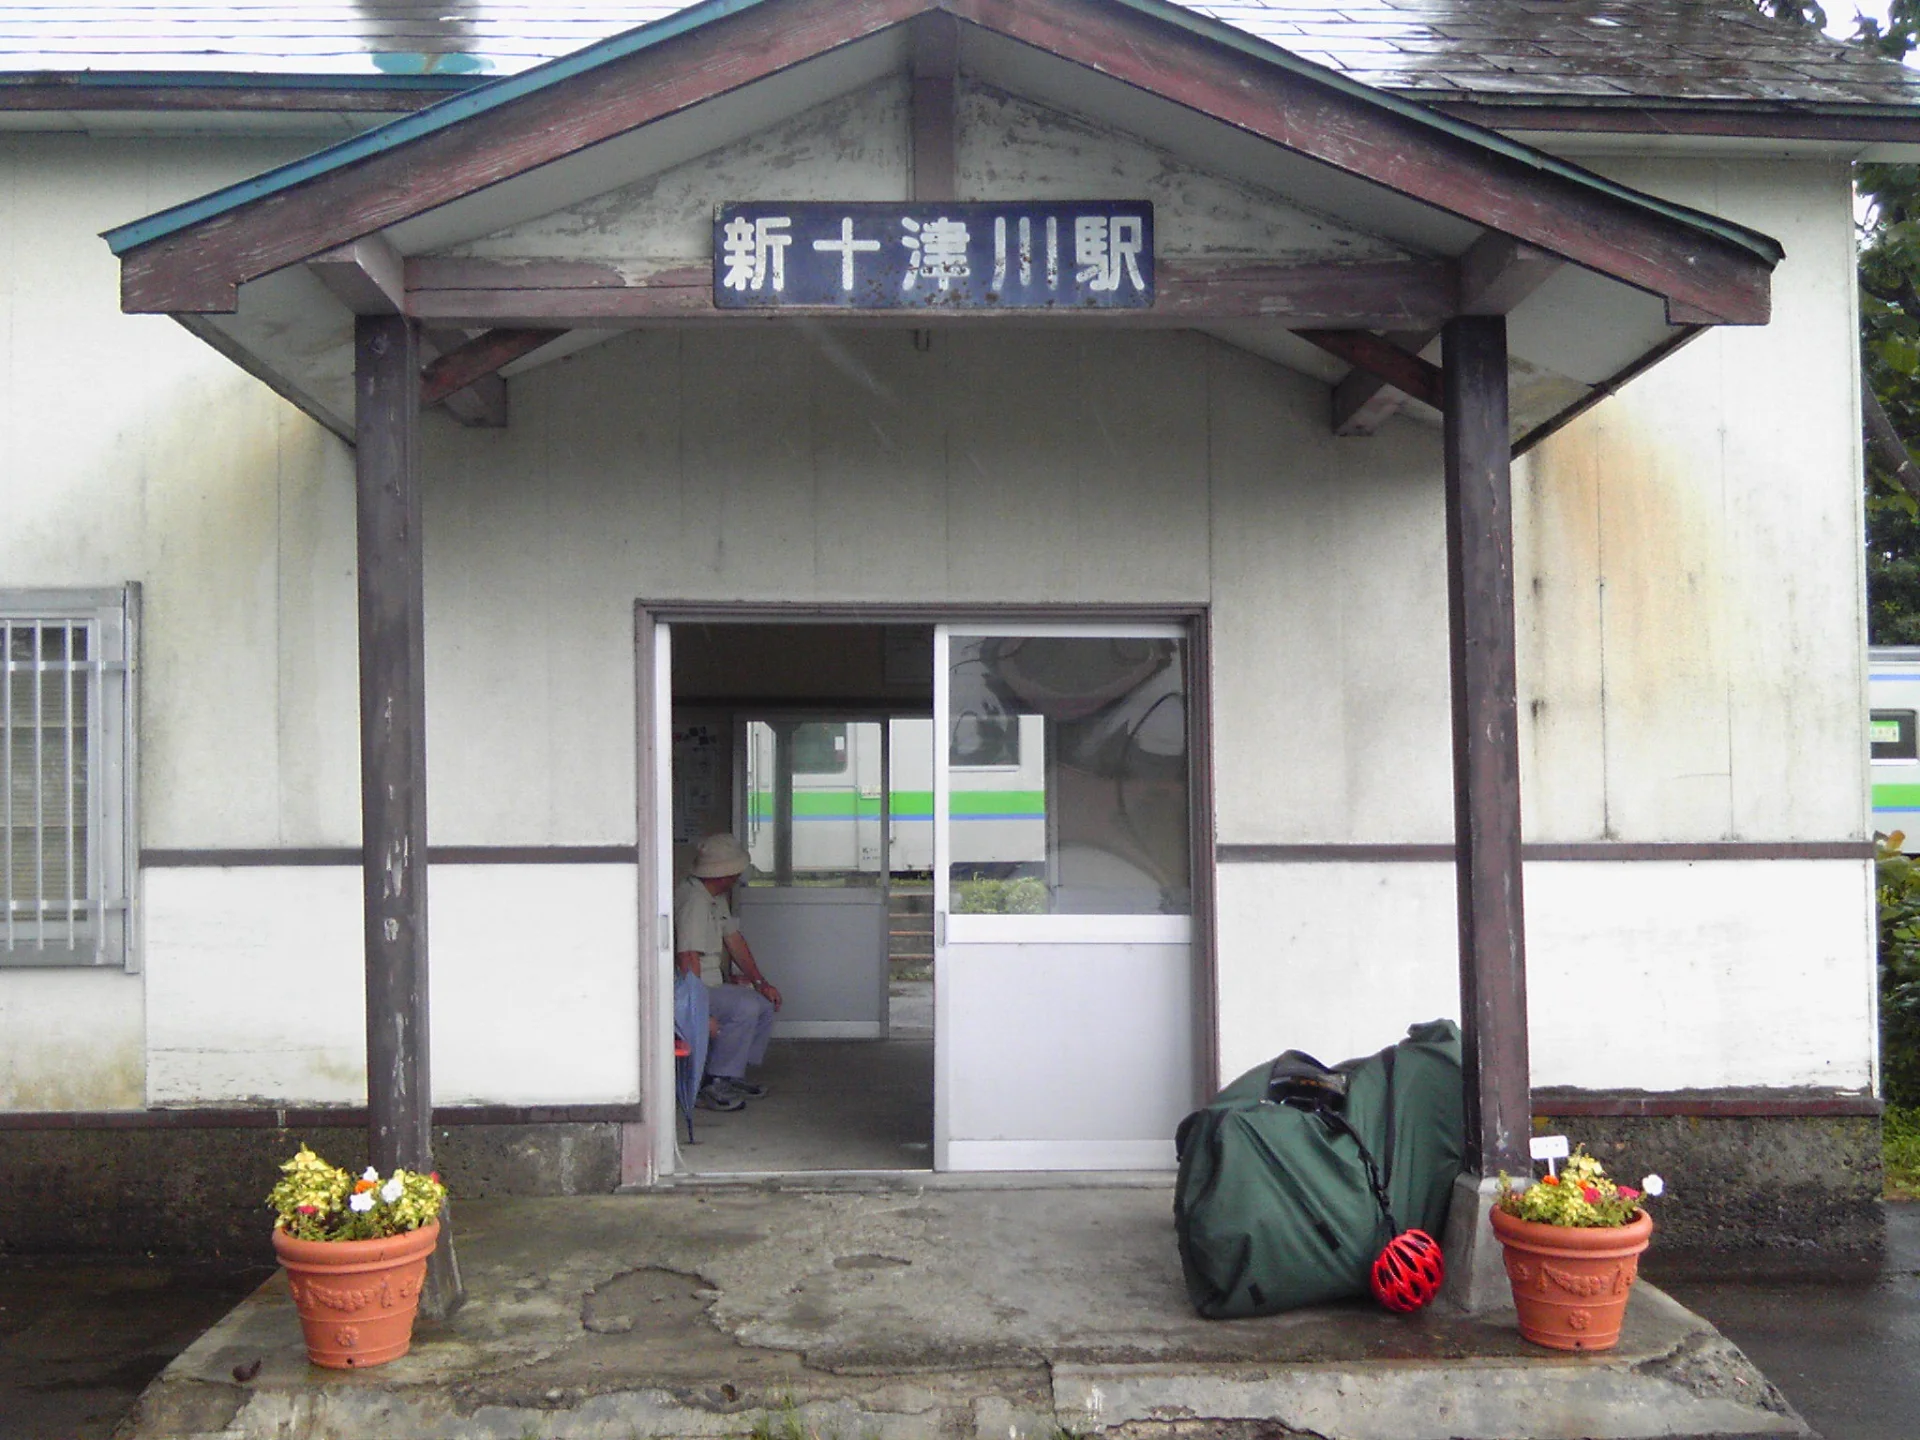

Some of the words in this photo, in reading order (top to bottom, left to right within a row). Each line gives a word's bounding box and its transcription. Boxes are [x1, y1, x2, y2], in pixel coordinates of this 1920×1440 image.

[723, 216, 1145, 291] 新十津川駅
